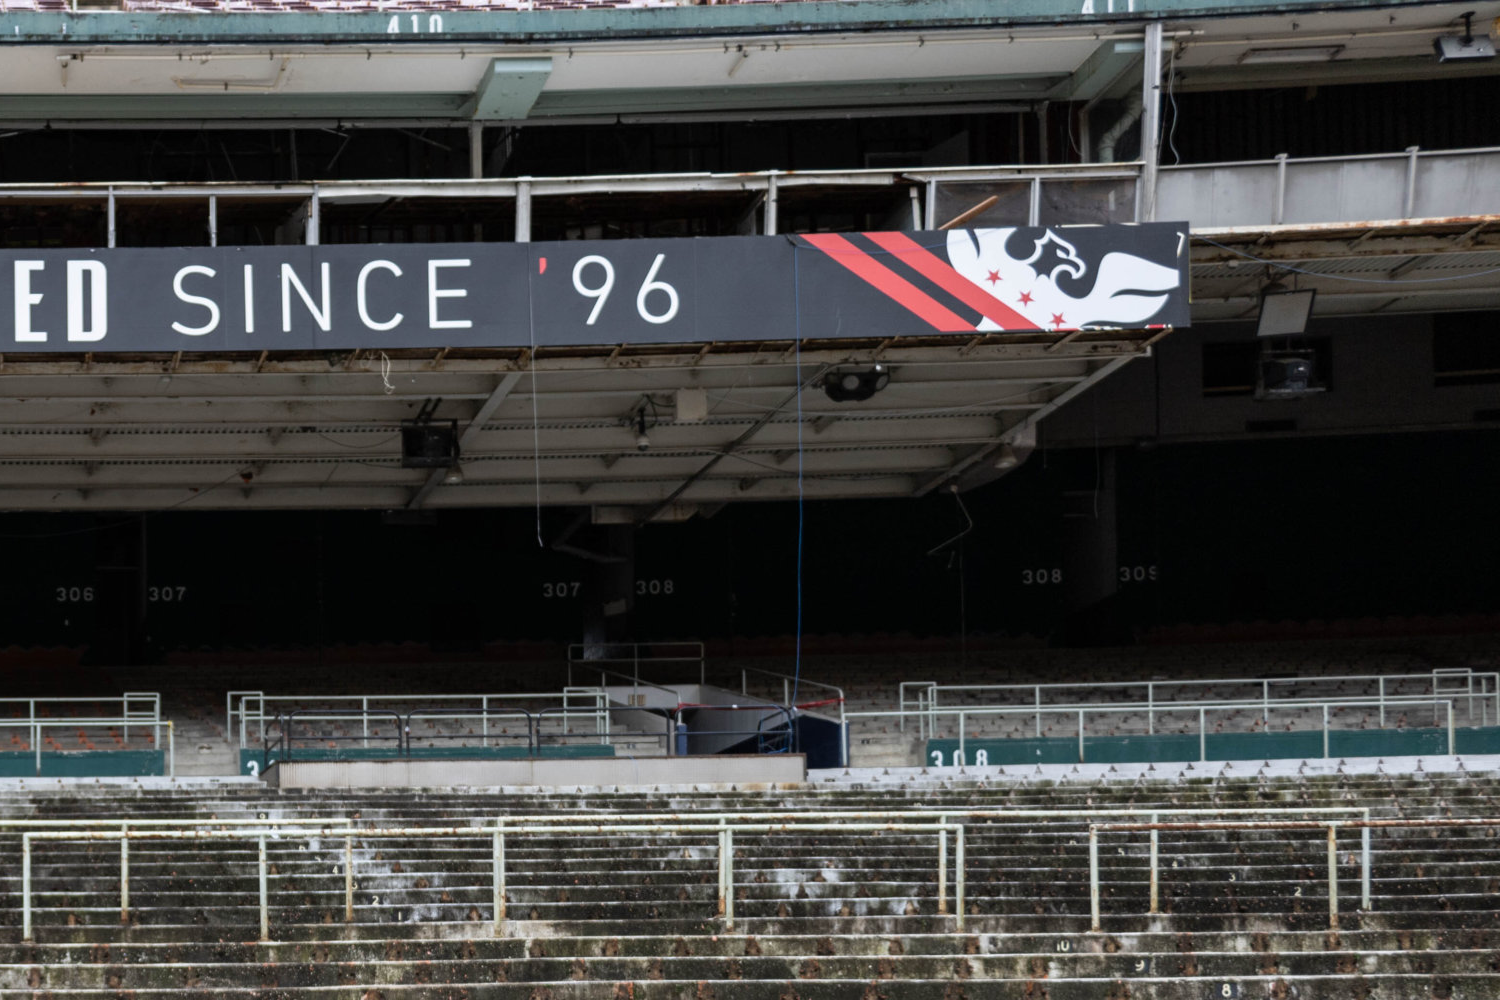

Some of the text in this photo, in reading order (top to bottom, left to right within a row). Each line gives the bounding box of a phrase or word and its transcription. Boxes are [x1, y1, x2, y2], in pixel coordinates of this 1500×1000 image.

[387, 14, 443, 34] 410
[172, 258, 471, 336] SINCE
[539, 253, 680, 327] '96
[1021, 569, 1063, 586] 308
[55, 587, 95, 603] 306
[148, 586, 189, 603] 307
[542, 582, 582, 598] 307
[635, 580, 675, 596] 308
[332, 865, 339, 875] 4
[1294, 886, 1302, 897] 2
[371, 895, 379, 905] 2
[1221, 983, 1232, 998] 8
